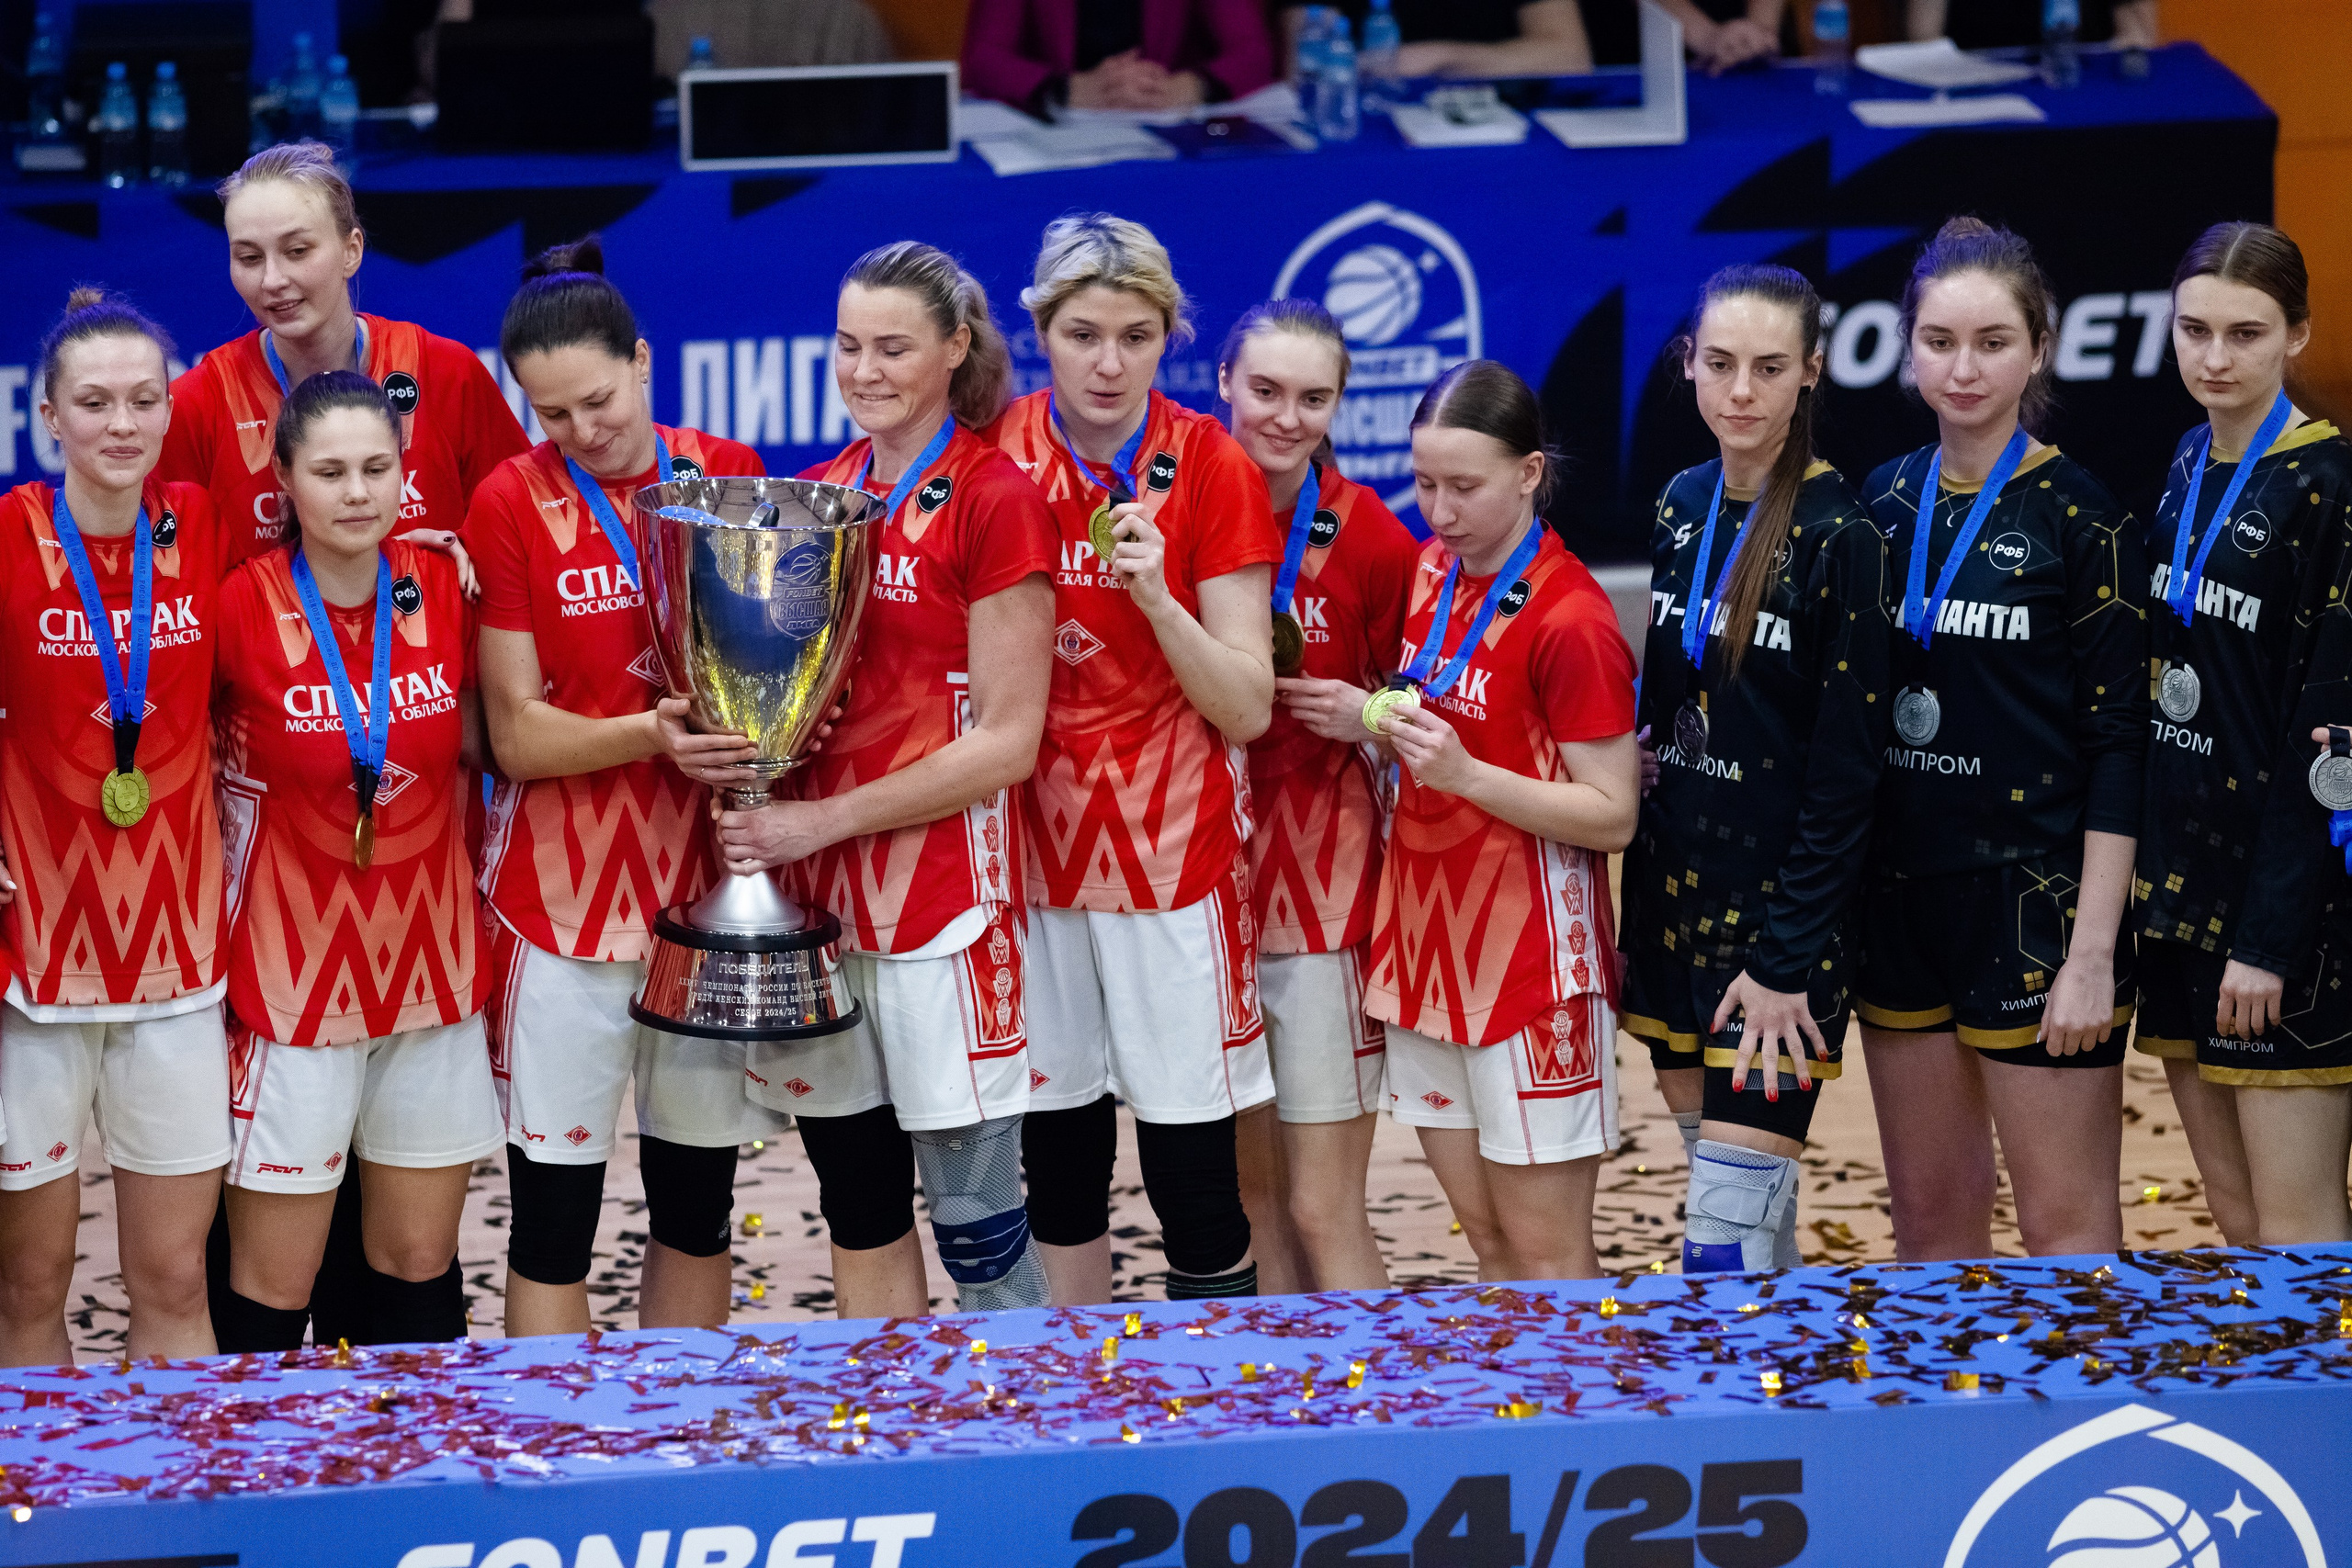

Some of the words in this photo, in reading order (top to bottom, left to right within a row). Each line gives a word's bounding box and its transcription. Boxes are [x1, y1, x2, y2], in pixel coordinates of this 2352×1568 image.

[388, 386, 415, 400] РФБ
[922, 452, 933, 464] ПО
[2236, 521, 2267, 542] РФБ
[1994, 544, 2025, 558] РФБ
[137, 579, 146, 609] РОССИИ
[786, 588, 823, 599] FONBET
[1503, 591, 1524, 605] РФБ
[39, 595, 200, 642] СПРАК
[778, 598, 830, 620] ВЫСШАЯ
[38, 641, 131, 657] МОСКОВА
[318, 628, 334, 658] РОССИИ
[378, 626, 388, 668] ЧЕМПИОНАТ
[329, 660, 339, 672] ПО
[376, 672, 385, 701] FONBET
[333, 673, 356, 723] БАСКЕТБОЛУ
[401, 696, 457, 721] ОБЛАСТЬ
[375, 705, 383, 727] XXXIV
[2151, 719, 2213, 756] ПРОМ
[1884, 746, 1981, 775] ИМПРОМ
[718, 962, 809, 978] ПОБЕДИТЕЛЬ
[758, 984, 788, 992] РОССИИ
[791, 983, 801, 991] ПО
[2001, 992, 2049, 1010] ХИМП
[764, 1008, 797, 1017] 2024/25
[2208, 1036, 2274, 1053] ХИМПРОМ
[1070, 1459, 1809, 1568] 2024/25
